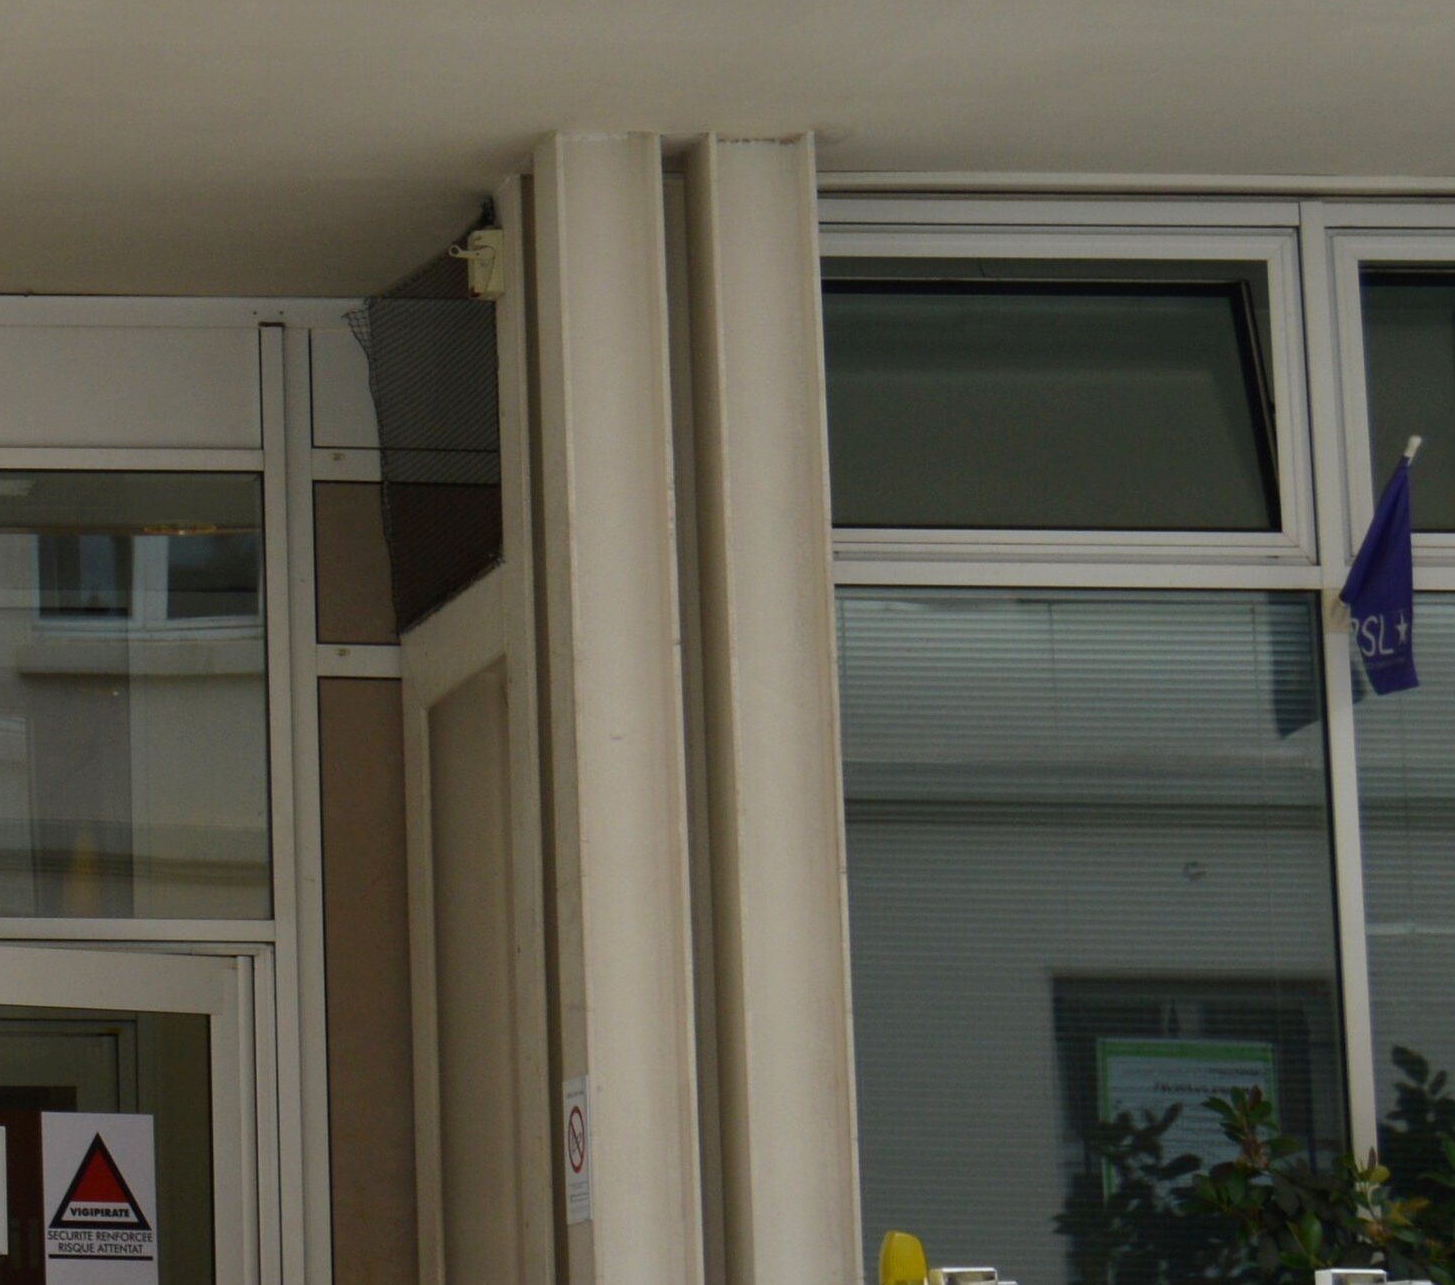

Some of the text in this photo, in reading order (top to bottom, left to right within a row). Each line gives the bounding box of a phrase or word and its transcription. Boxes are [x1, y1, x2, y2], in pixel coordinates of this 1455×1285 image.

[70, 1207, 130, 1218] VIGIPIRATE
[47, 1230, 153, 1243] SECURITE RENFORCEE
[58, 1243, 144, 1254] RISQUE ATTENTAT
